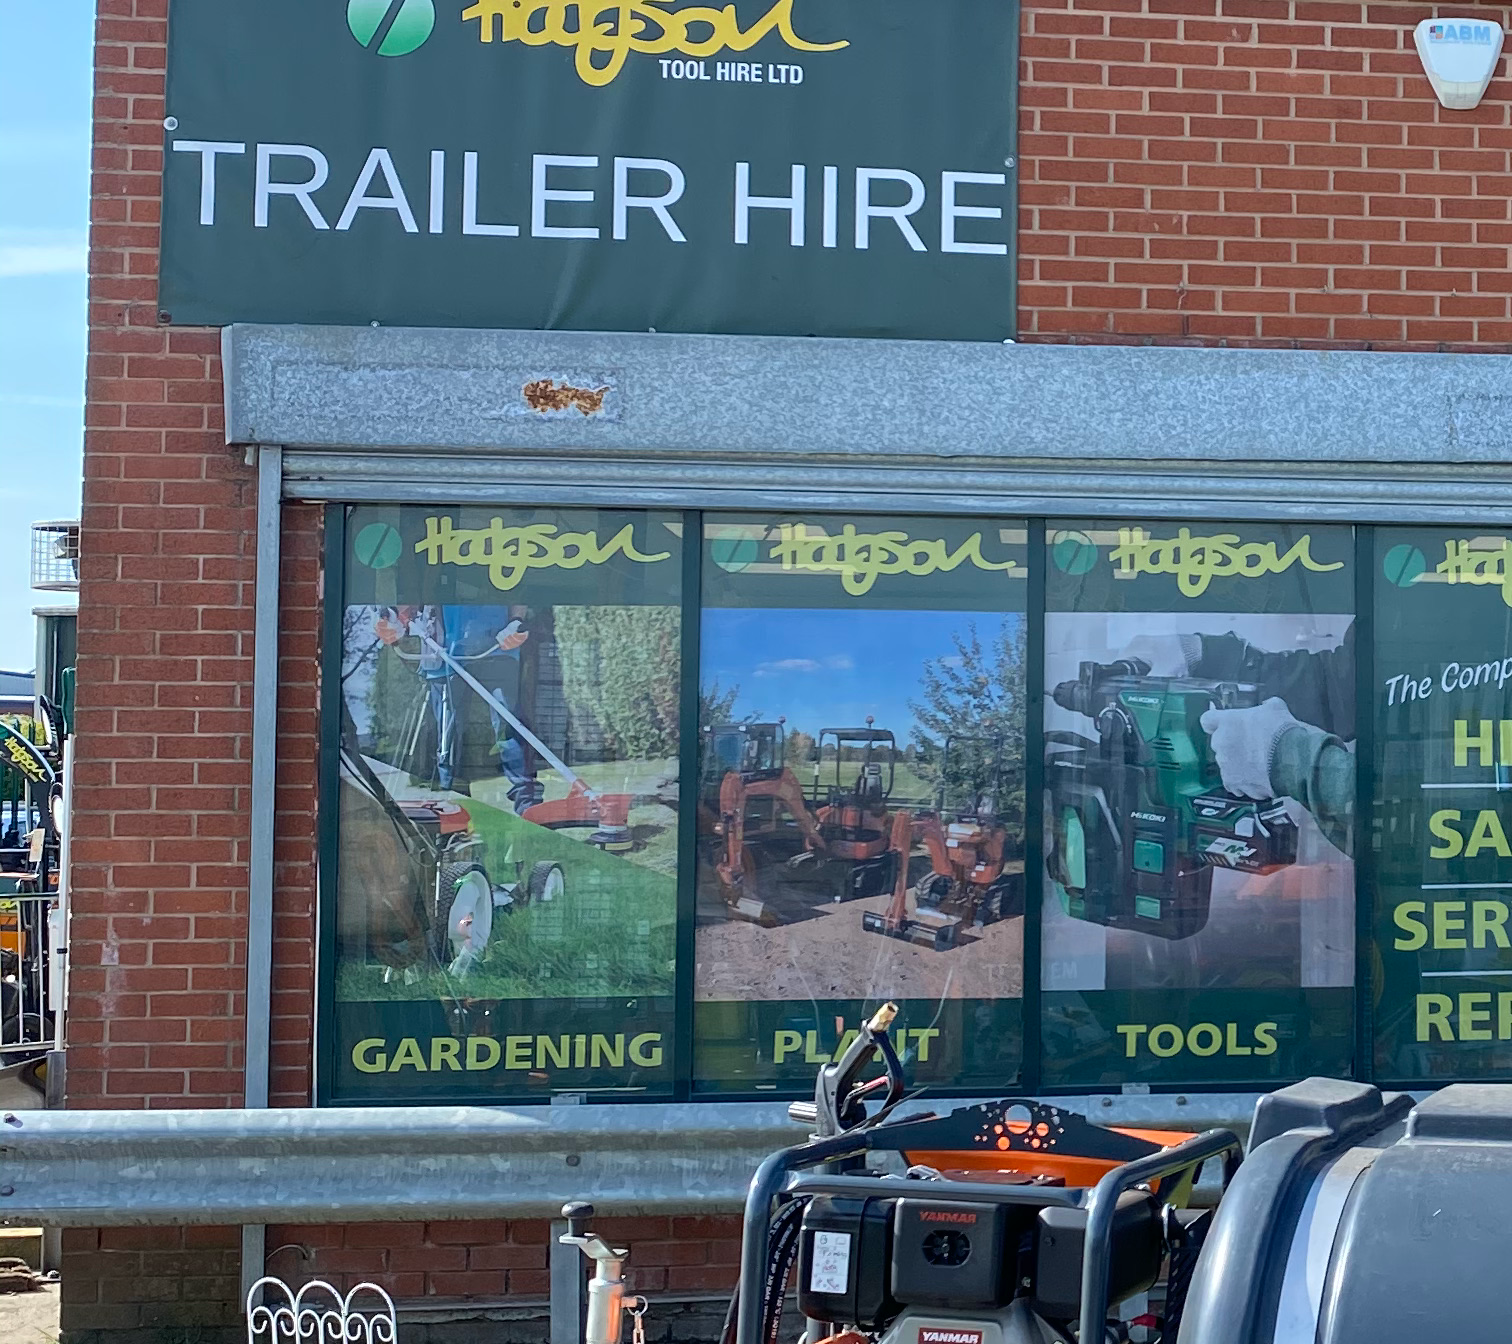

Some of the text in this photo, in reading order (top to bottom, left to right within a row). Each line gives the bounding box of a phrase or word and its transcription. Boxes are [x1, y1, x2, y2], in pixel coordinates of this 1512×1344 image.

[1443, 25, 1492, 42] ABM
[658, 58, 804, 85] TOOL HIRE LTD
[172, 139, 1009, 255] TRAILER HIRE
[414, 516, 671, 591] Hodgson
[769, 523, 1016, 596] Hodgson
[1108, 527, 1344, 598] Hodgson
[1385, 674, 1433, 706] The
[352, 1032, 663, 1074] GARDENING
[1117, 1022, 1278, 1058] TOOLS
[920, 1211, 976, 1224] YANMAR
[922, 1331, 979, 1344] YANMAR
